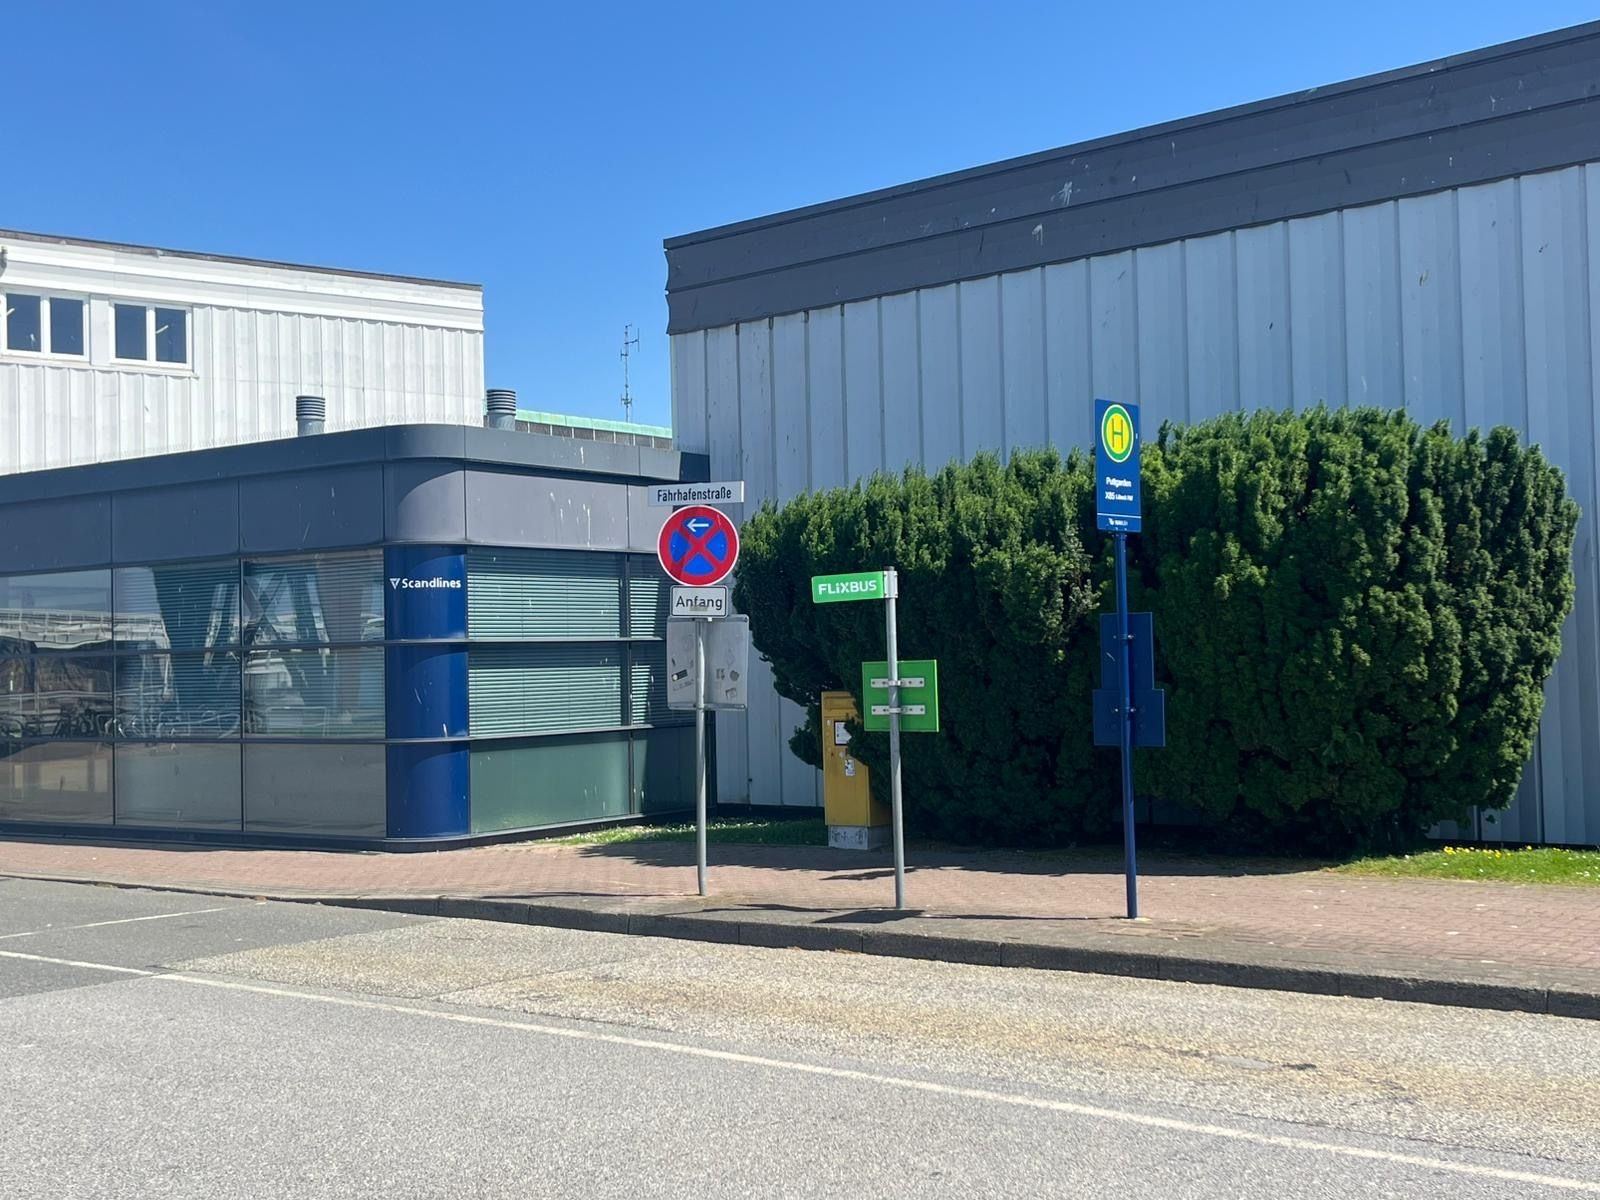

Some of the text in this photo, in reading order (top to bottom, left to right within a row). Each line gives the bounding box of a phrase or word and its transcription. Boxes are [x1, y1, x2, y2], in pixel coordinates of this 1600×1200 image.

[1111, 417, 1124, 450] H
[657, 487, 732, 502] Fährhafenstraße
[402, 577, 461, 589] Scandlines
[675, 596, 723, 610] Anfang
